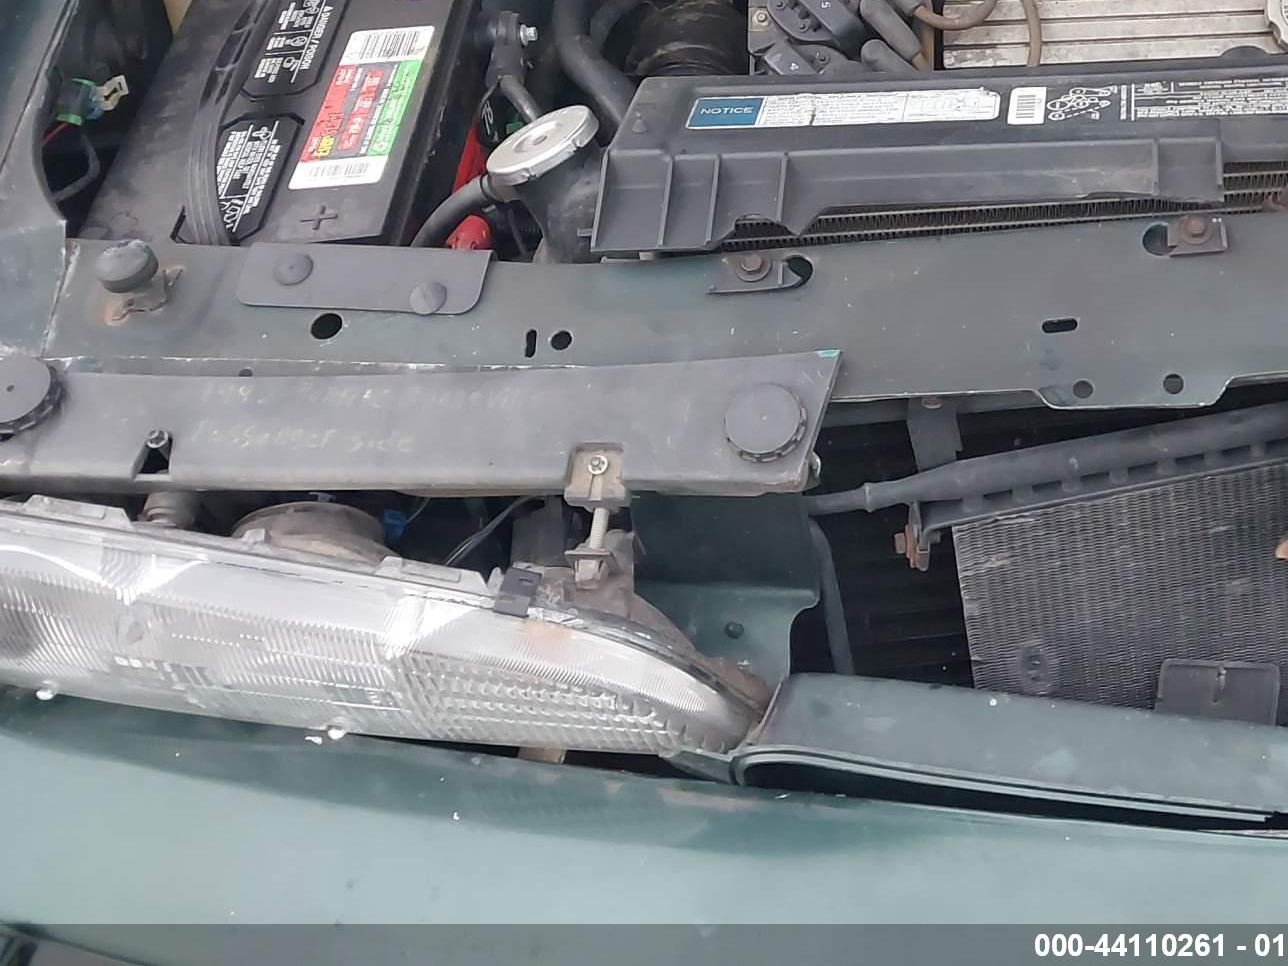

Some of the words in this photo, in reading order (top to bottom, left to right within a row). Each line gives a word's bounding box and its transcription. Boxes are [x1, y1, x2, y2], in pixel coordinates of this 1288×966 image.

[820, 1, 831, 9] 5
[789, 62, 800, 71] 4
[700, 106, 753, 115] NOTICE
